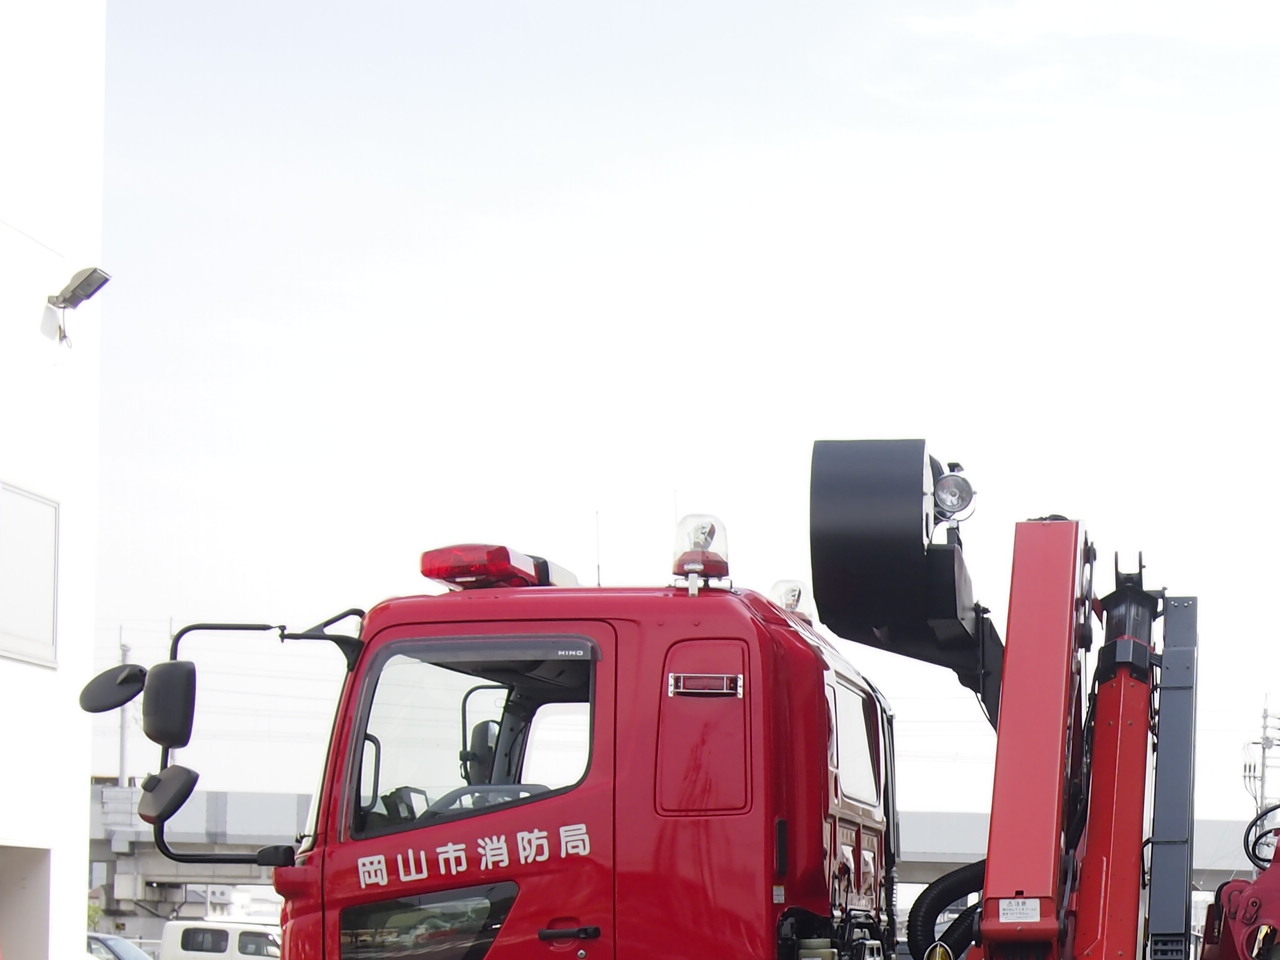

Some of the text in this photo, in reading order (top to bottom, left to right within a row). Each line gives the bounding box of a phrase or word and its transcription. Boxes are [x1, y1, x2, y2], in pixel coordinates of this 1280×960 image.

[357, 823, 591, 889] 岡山市消防局
